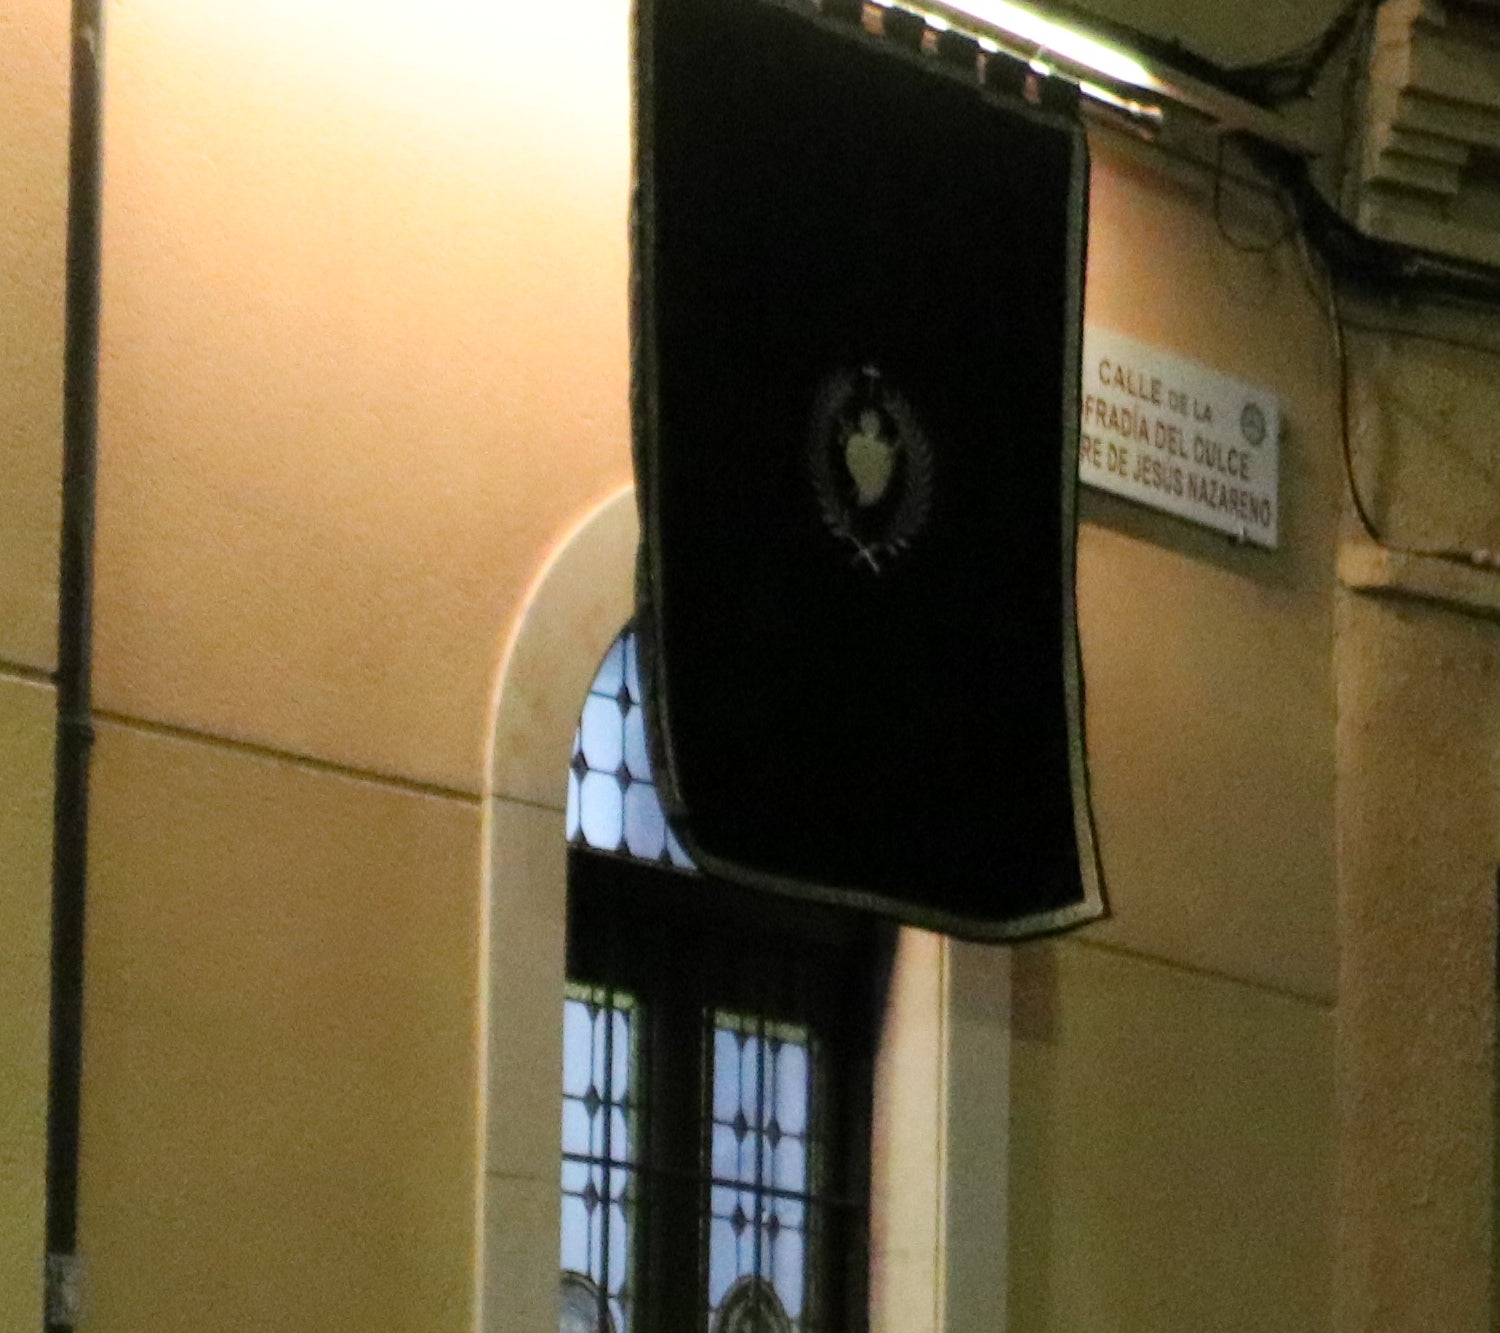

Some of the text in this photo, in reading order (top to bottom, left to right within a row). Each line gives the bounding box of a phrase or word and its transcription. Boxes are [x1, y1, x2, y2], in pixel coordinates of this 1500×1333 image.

[1098, 358, 1213, 424] CALLE DE LA
[1080, 433, 1103, 470] RE
[1106, 441, 1129, 478] DE
[1187, 471, 1272, 528] NAZARENO
[1083, 393, 1252, 483] FRADÍA DEL DULCE
